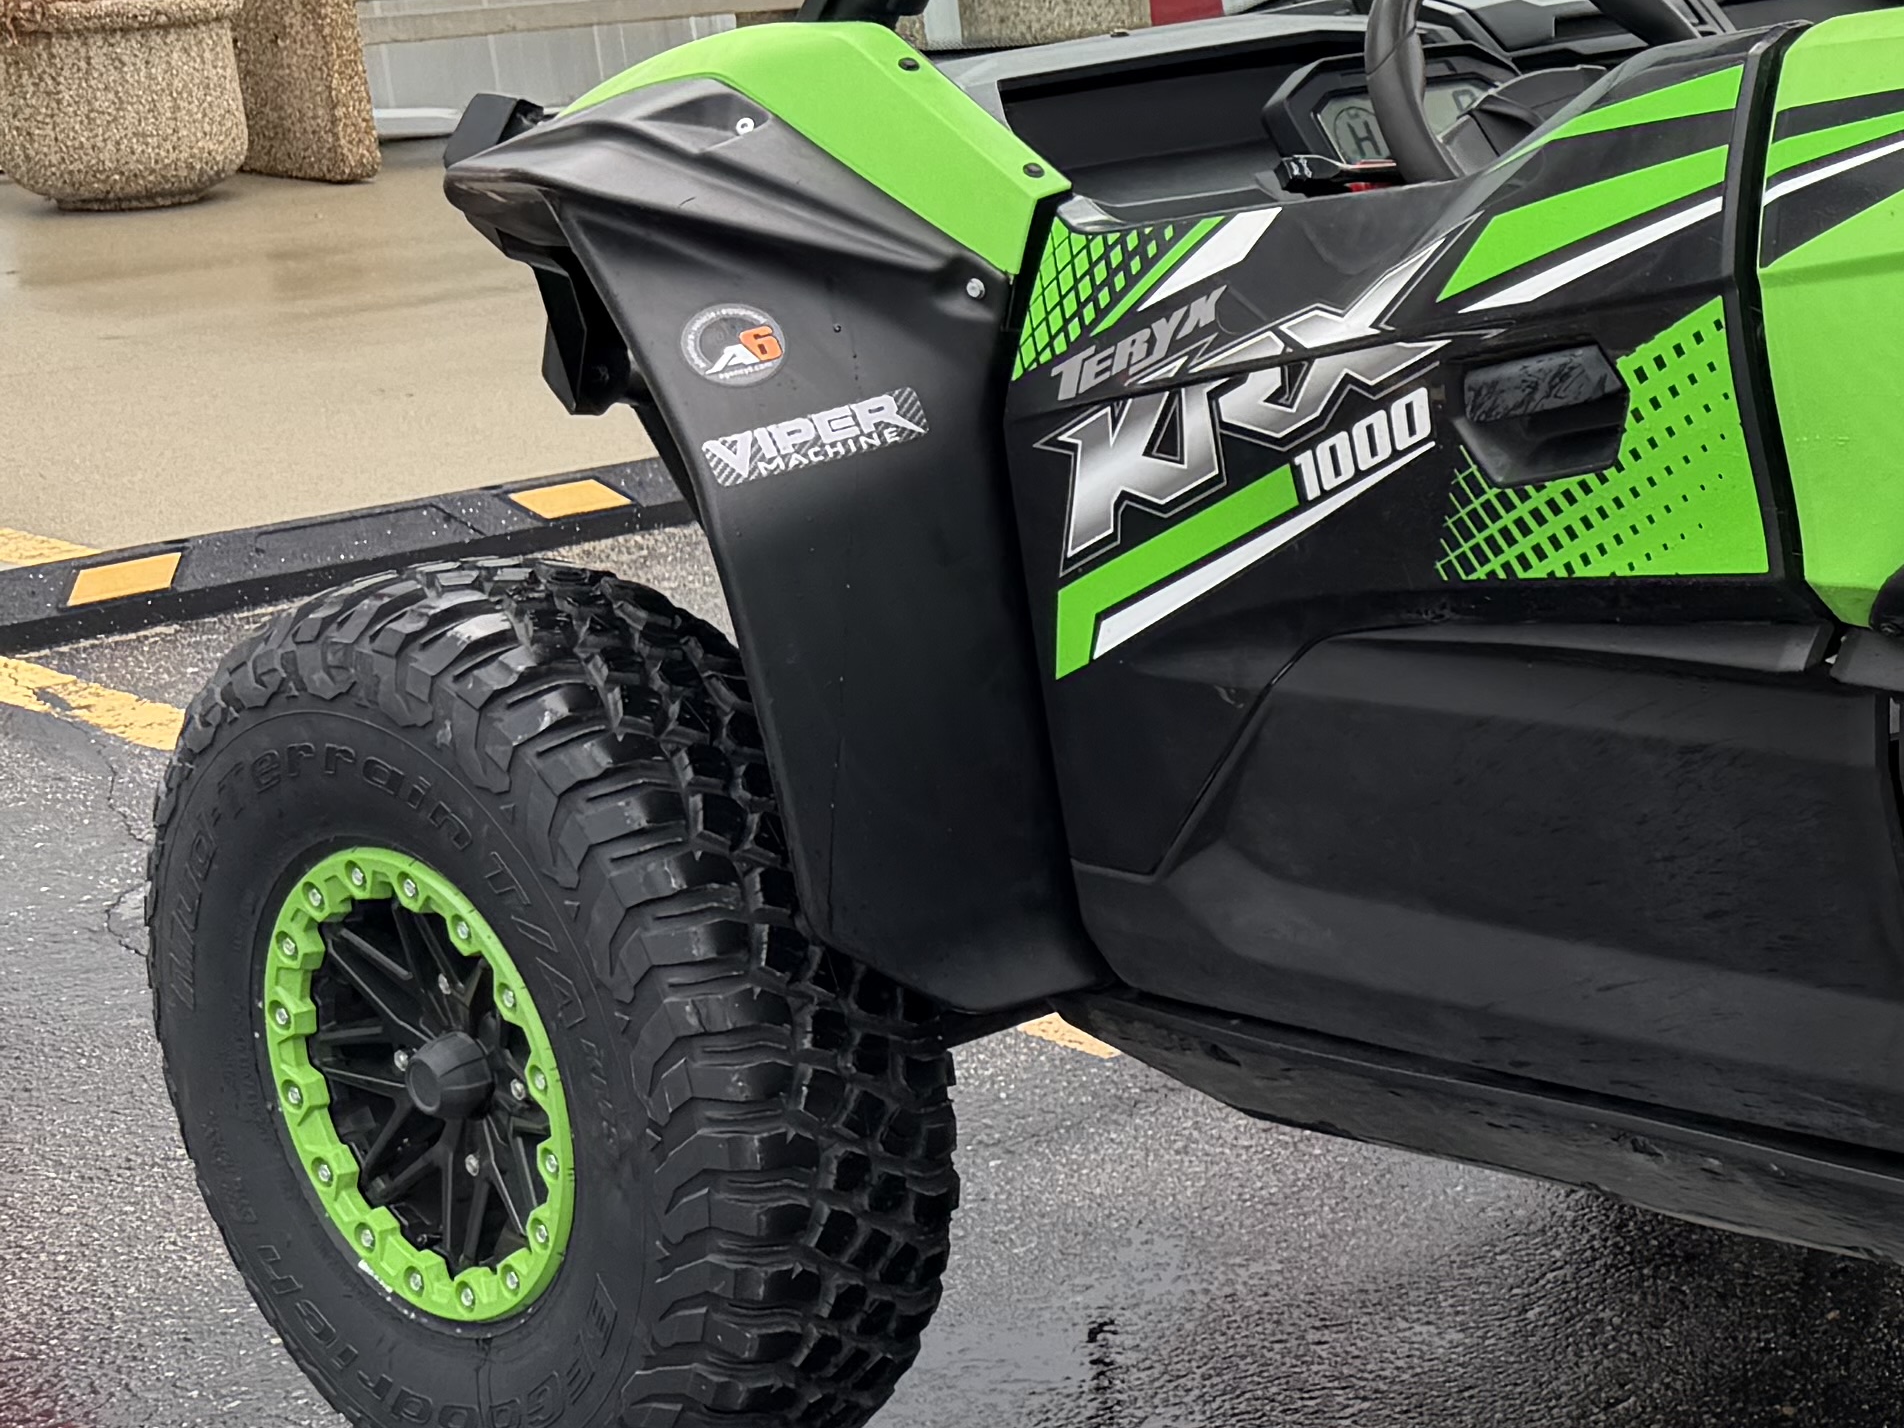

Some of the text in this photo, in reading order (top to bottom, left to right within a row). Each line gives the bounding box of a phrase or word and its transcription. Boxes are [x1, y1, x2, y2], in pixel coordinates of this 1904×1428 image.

[1050, 285, 1228, 402] TERYX
[1050, 232, 1458, 562] KRX
[702, 394, 927, 479] VIPER
[756, 426, 900, 476] MACHINE
[1294, 386, 1431, 501] 1000
